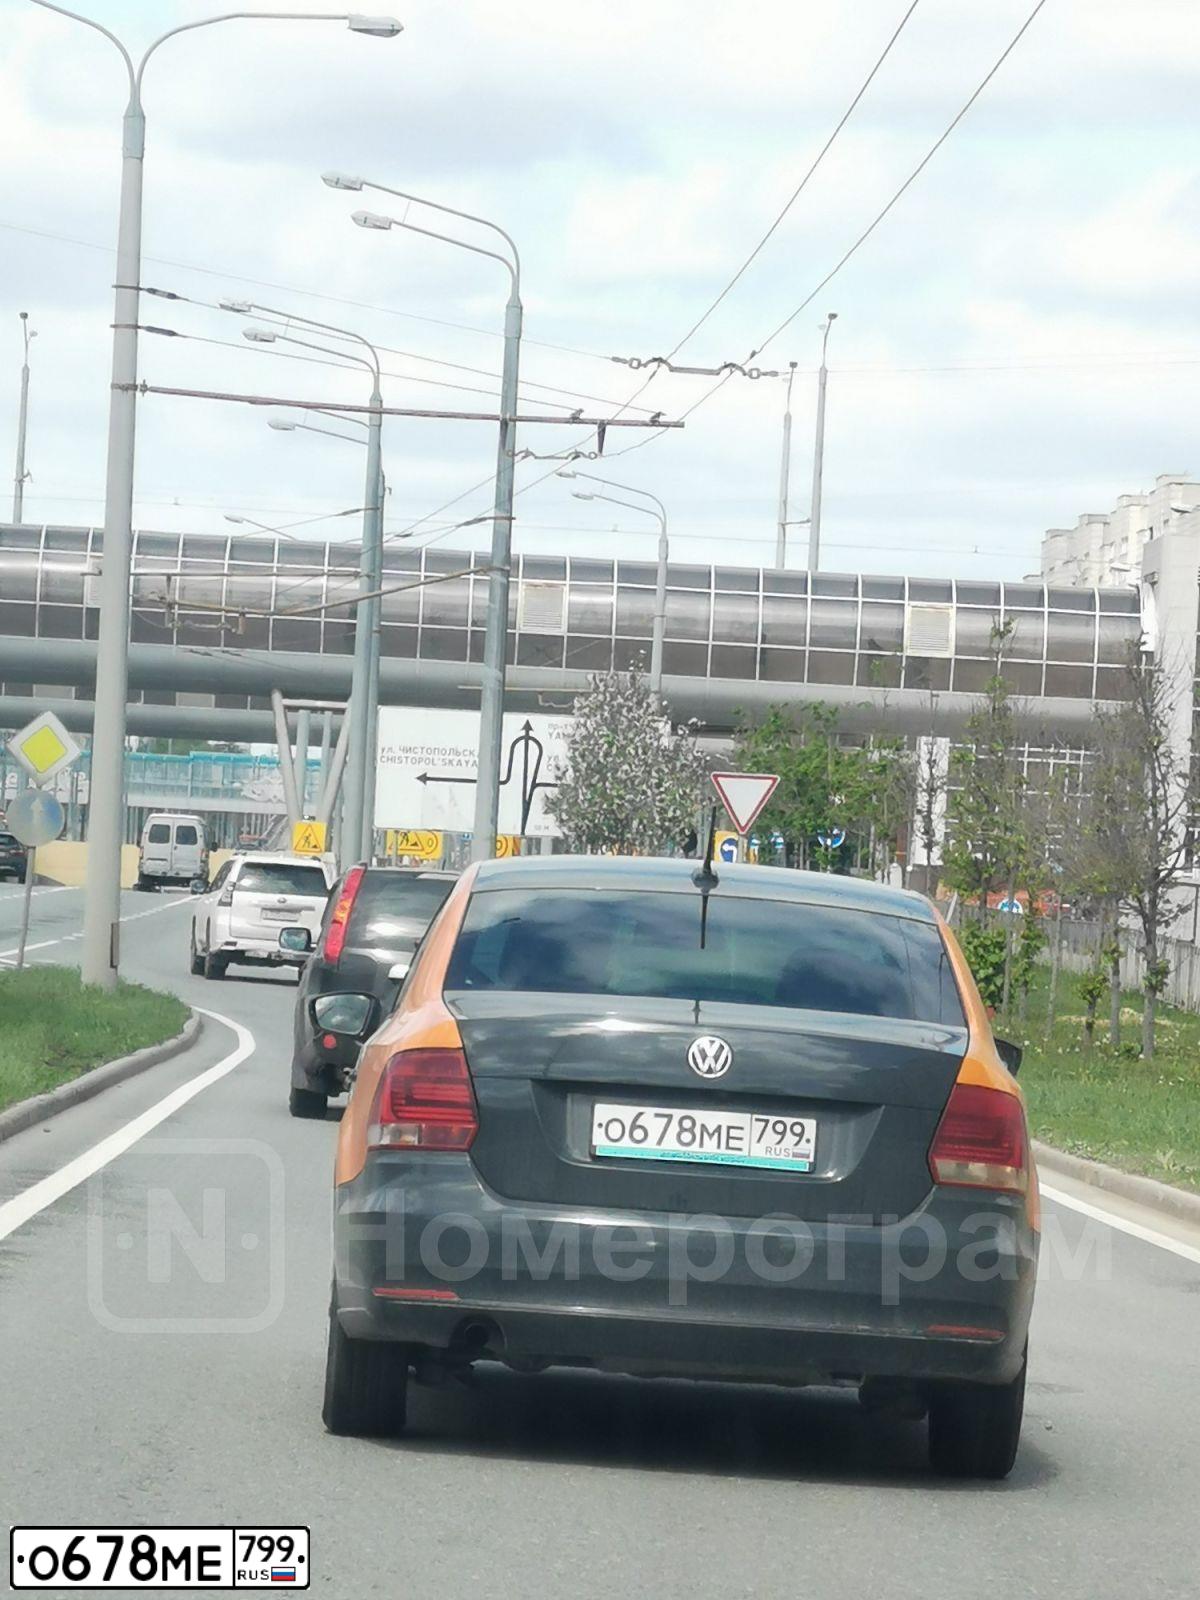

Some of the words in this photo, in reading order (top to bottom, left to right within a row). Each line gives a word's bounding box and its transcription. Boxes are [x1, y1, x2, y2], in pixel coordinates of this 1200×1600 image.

[398, 744, 476, 758] ЧИСТОПОЛЬСК
[754, 1117, 806, 1146] 799
[765, 1146, 791, 1158] RUS
